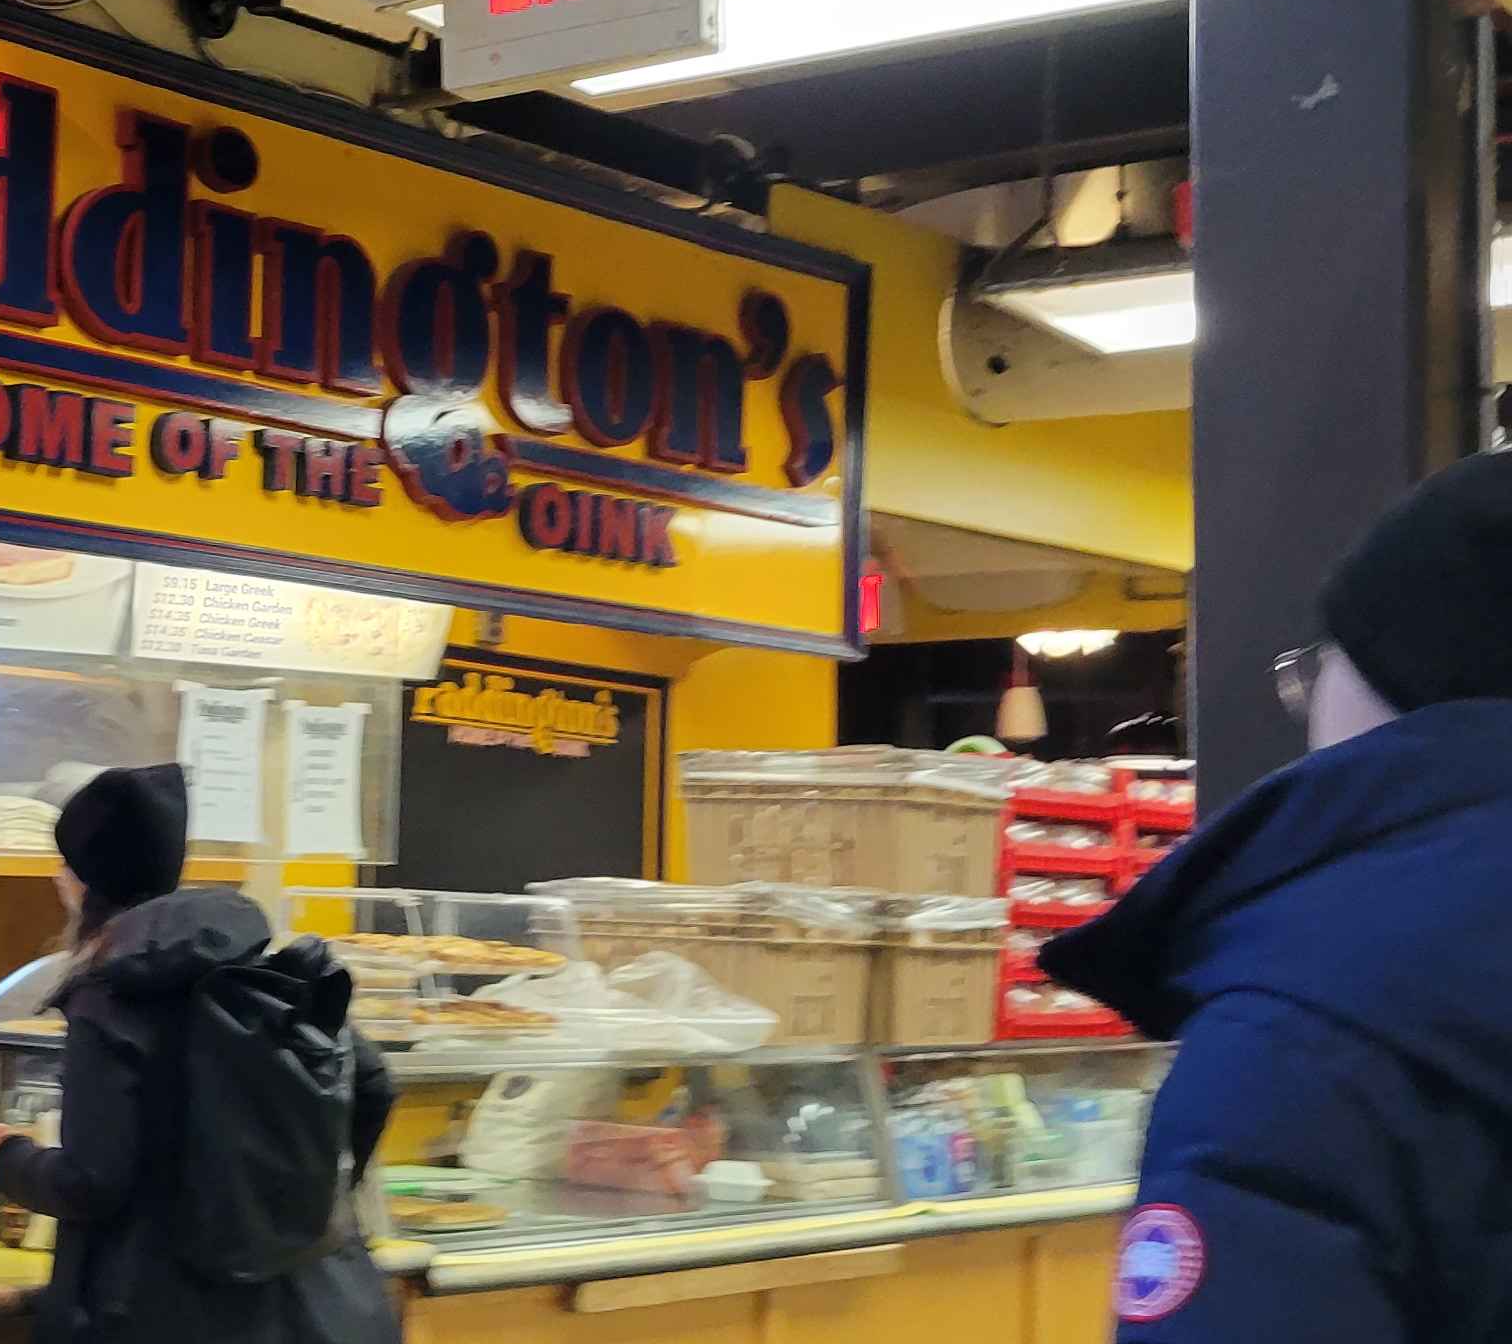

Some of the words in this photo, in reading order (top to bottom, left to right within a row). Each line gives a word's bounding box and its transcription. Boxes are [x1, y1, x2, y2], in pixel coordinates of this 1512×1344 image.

[150, 411, 243, 482] OF
[255, 427, 385, 507] THE
[519, 482, 678, 569] OINK
[163, 576, 198, 590] $9.15
[205, 580, 238, 596] Large
[241, 584, 275, 597] Greek
[203, 597, 249, 611] Chicken
[252, 601, 293, 615] Garden
[199, 613, 245, 627] Chicken
[248, 617, 280, 630] Greek
[194, 628, 241, 642] Chicken
